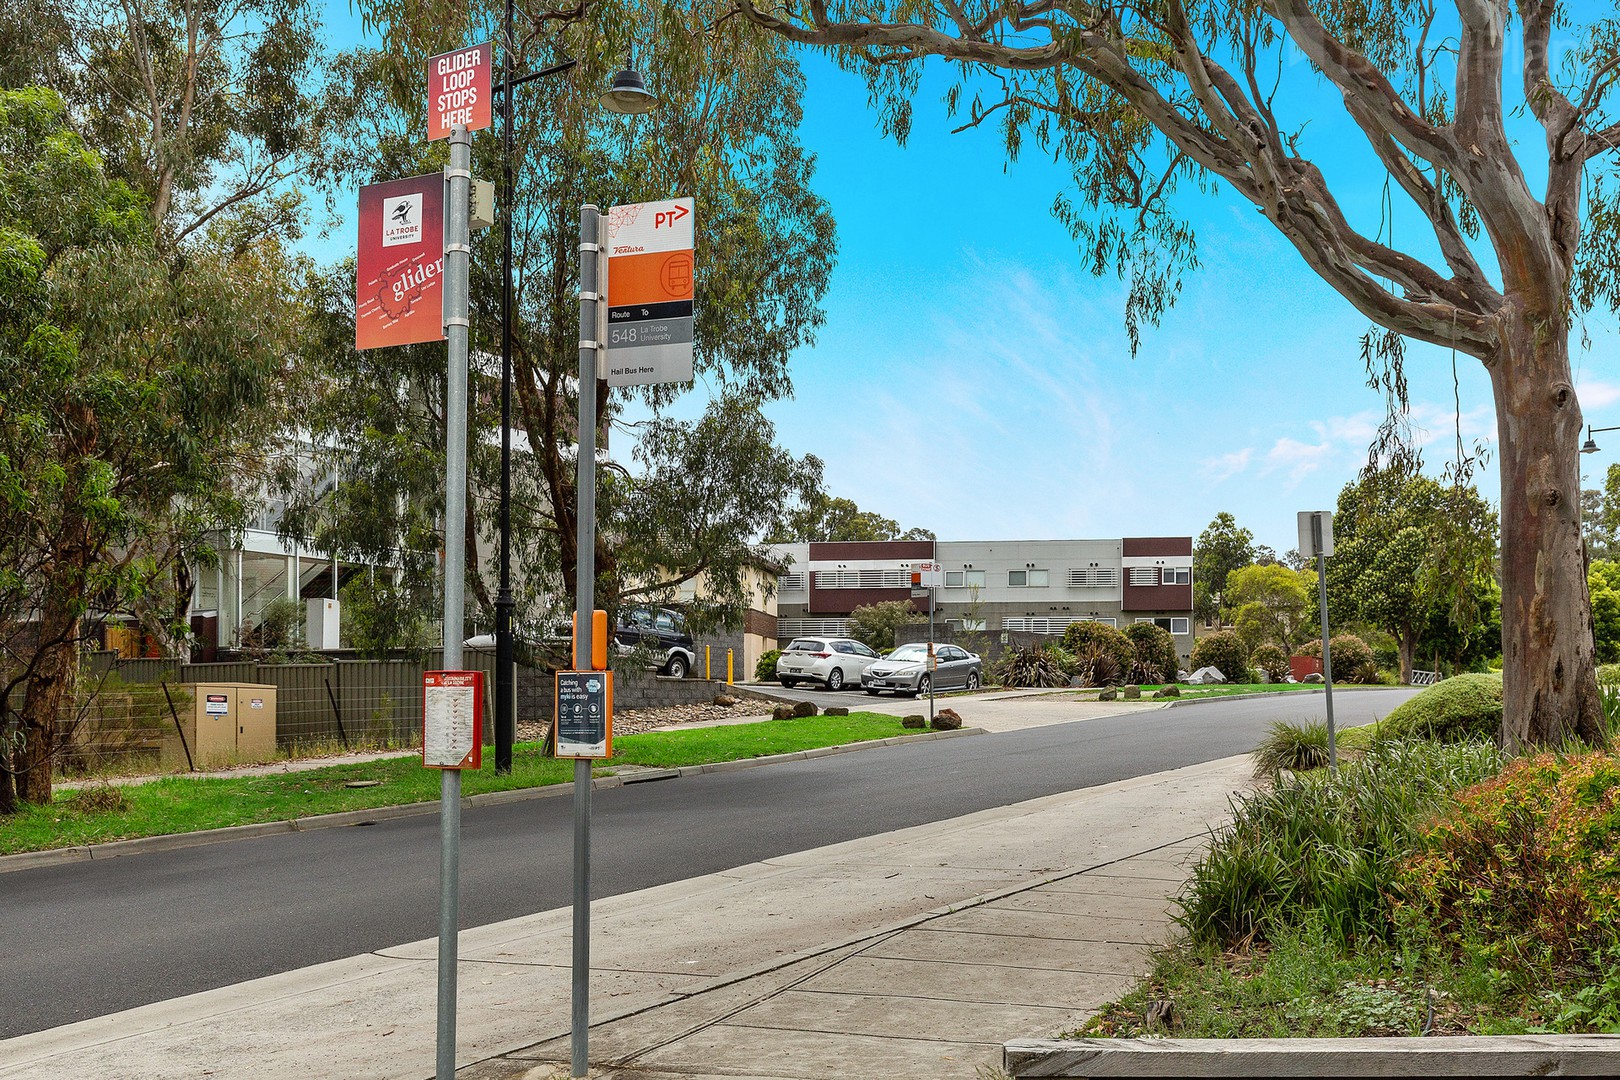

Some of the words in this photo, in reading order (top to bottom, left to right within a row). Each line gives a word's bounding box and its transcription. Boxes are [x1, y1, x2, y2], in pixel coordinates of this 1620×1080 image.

[437, 49, 481, 76] GLIDER
[443, 69, 475, 92] LOOP
[437, 87, 477, 112] STOPS
[441, 106, 473, 130] HERE
[386, 228, 394, 237] LA
[395, 225, 419, 235] TROBE
[613, 245, 645, 254] Ventura
[392, 258, 443, 302] glider
[611, 311, 631, 319] Route
[641, 308, 650, 316] To
[650, 324, 668, 332] Trobe
[611, 328, 637, 344] 548
[640, 333, 672, 342] University
[638, 366, 654, 374] Here
[560, 679, 578, 687] Catching
